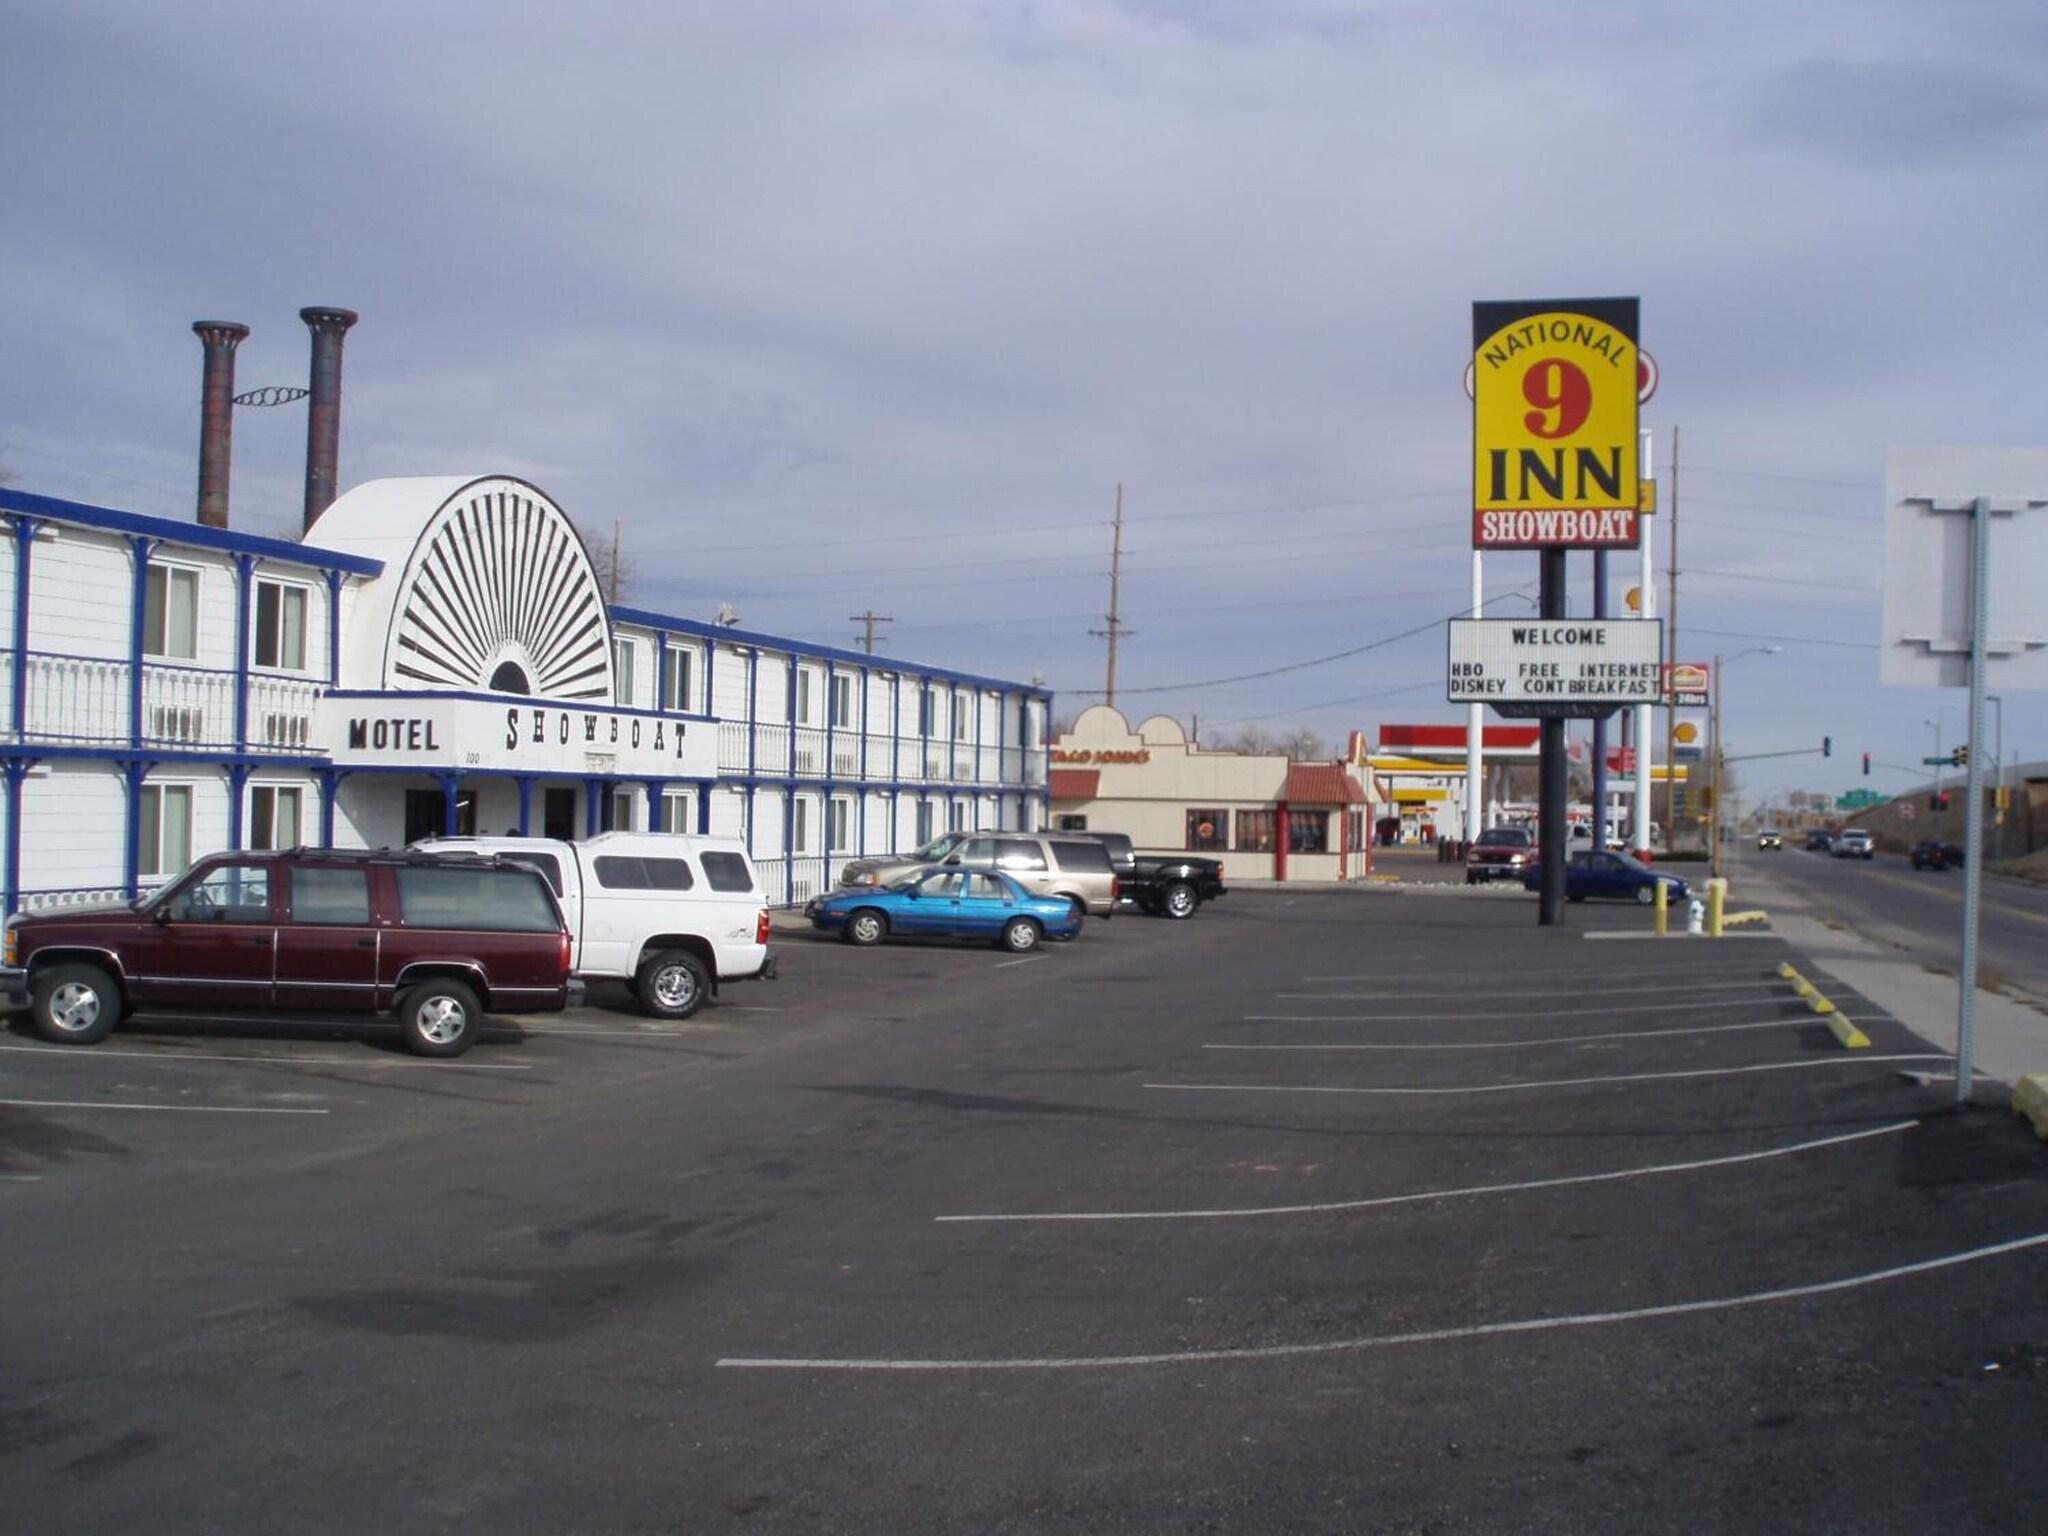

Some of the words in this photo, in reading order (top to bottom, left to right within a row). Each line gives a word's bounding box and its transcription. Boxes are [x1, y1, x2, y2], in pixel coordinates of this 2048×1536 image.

[1484, 319, 1627, 370] NATIONAL
[1522, 357, 1593, 440] 9
[1489, 446, 1623, 502] INN
[1482, 509, 1633, 541] SHOWBOAT
[1512, 627, 1607, 645] WELCOME
[1452, 663, 1484, 677] HBO
[1519, 663, 1560, 677] FREE
[1580, 663, 1660, 678] INTERNET
[1451, 679, 1506, 694] DISNEY
[1523, 679, 1566, 694] CONT
[1568, 680, 1660, 695] BREAKFAST
[349, 718, 440, 750] MOTEL
[506, 708, 686, 759] SHOWBOAT
